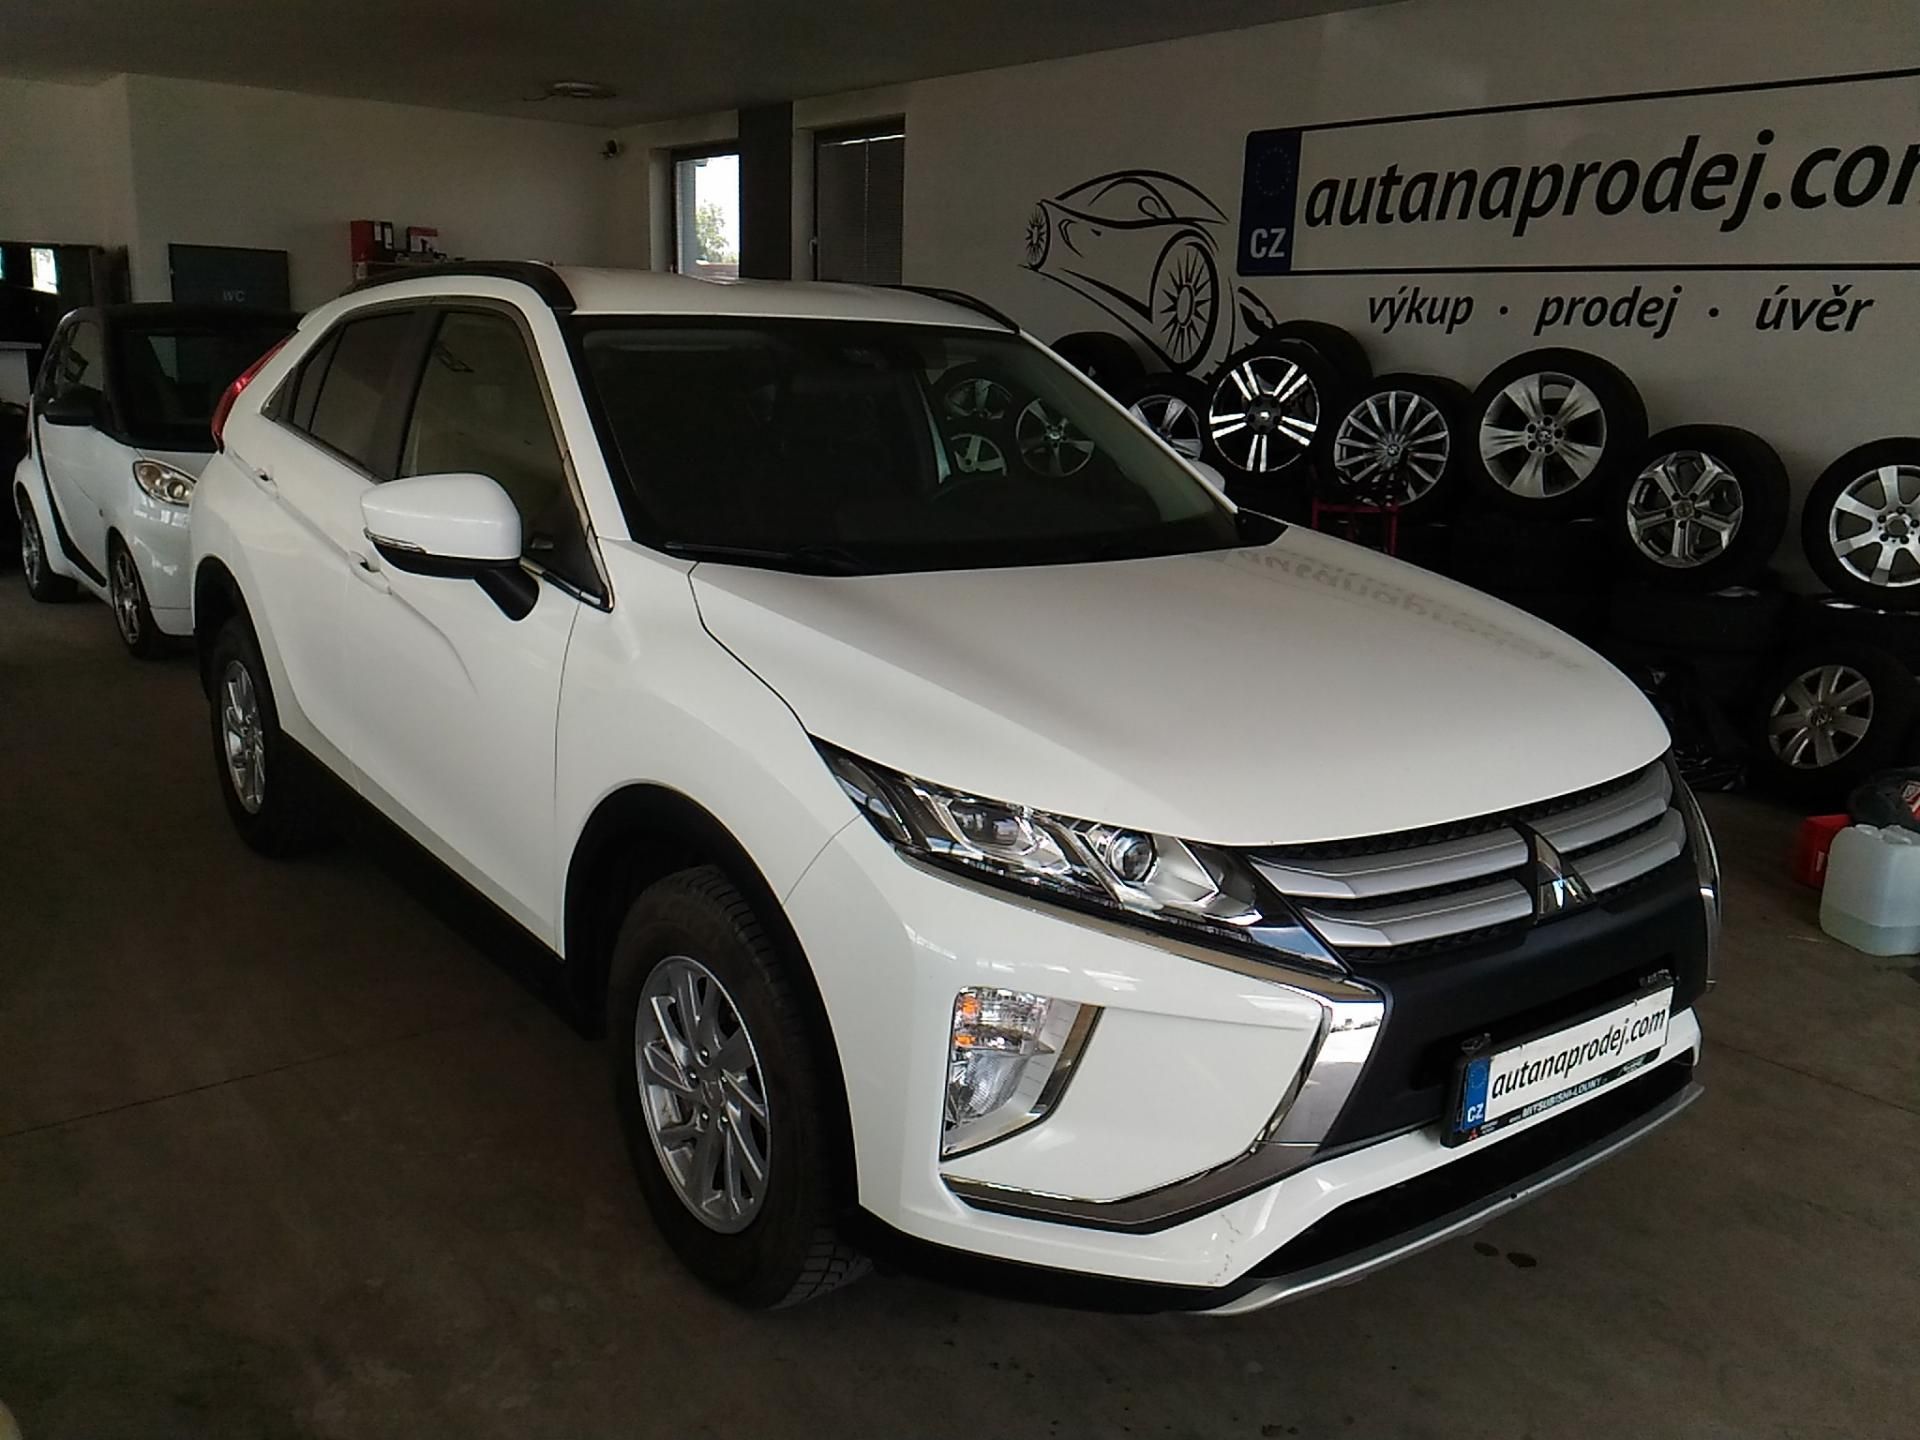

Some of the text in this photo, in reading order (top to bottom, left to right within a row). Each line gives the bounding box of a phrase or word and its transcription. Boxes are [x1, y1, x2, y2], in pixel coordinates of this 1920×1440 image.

[1250, 228, 1286, 258] CZ
[223, 290, 245, 302] WC
[1369, 284, 1875, 338] výkup prodej úvěr
[1491, 1007, 1667, 1100] autanaprodej.com
[1466, 1102, 1485, 1123] CZ
